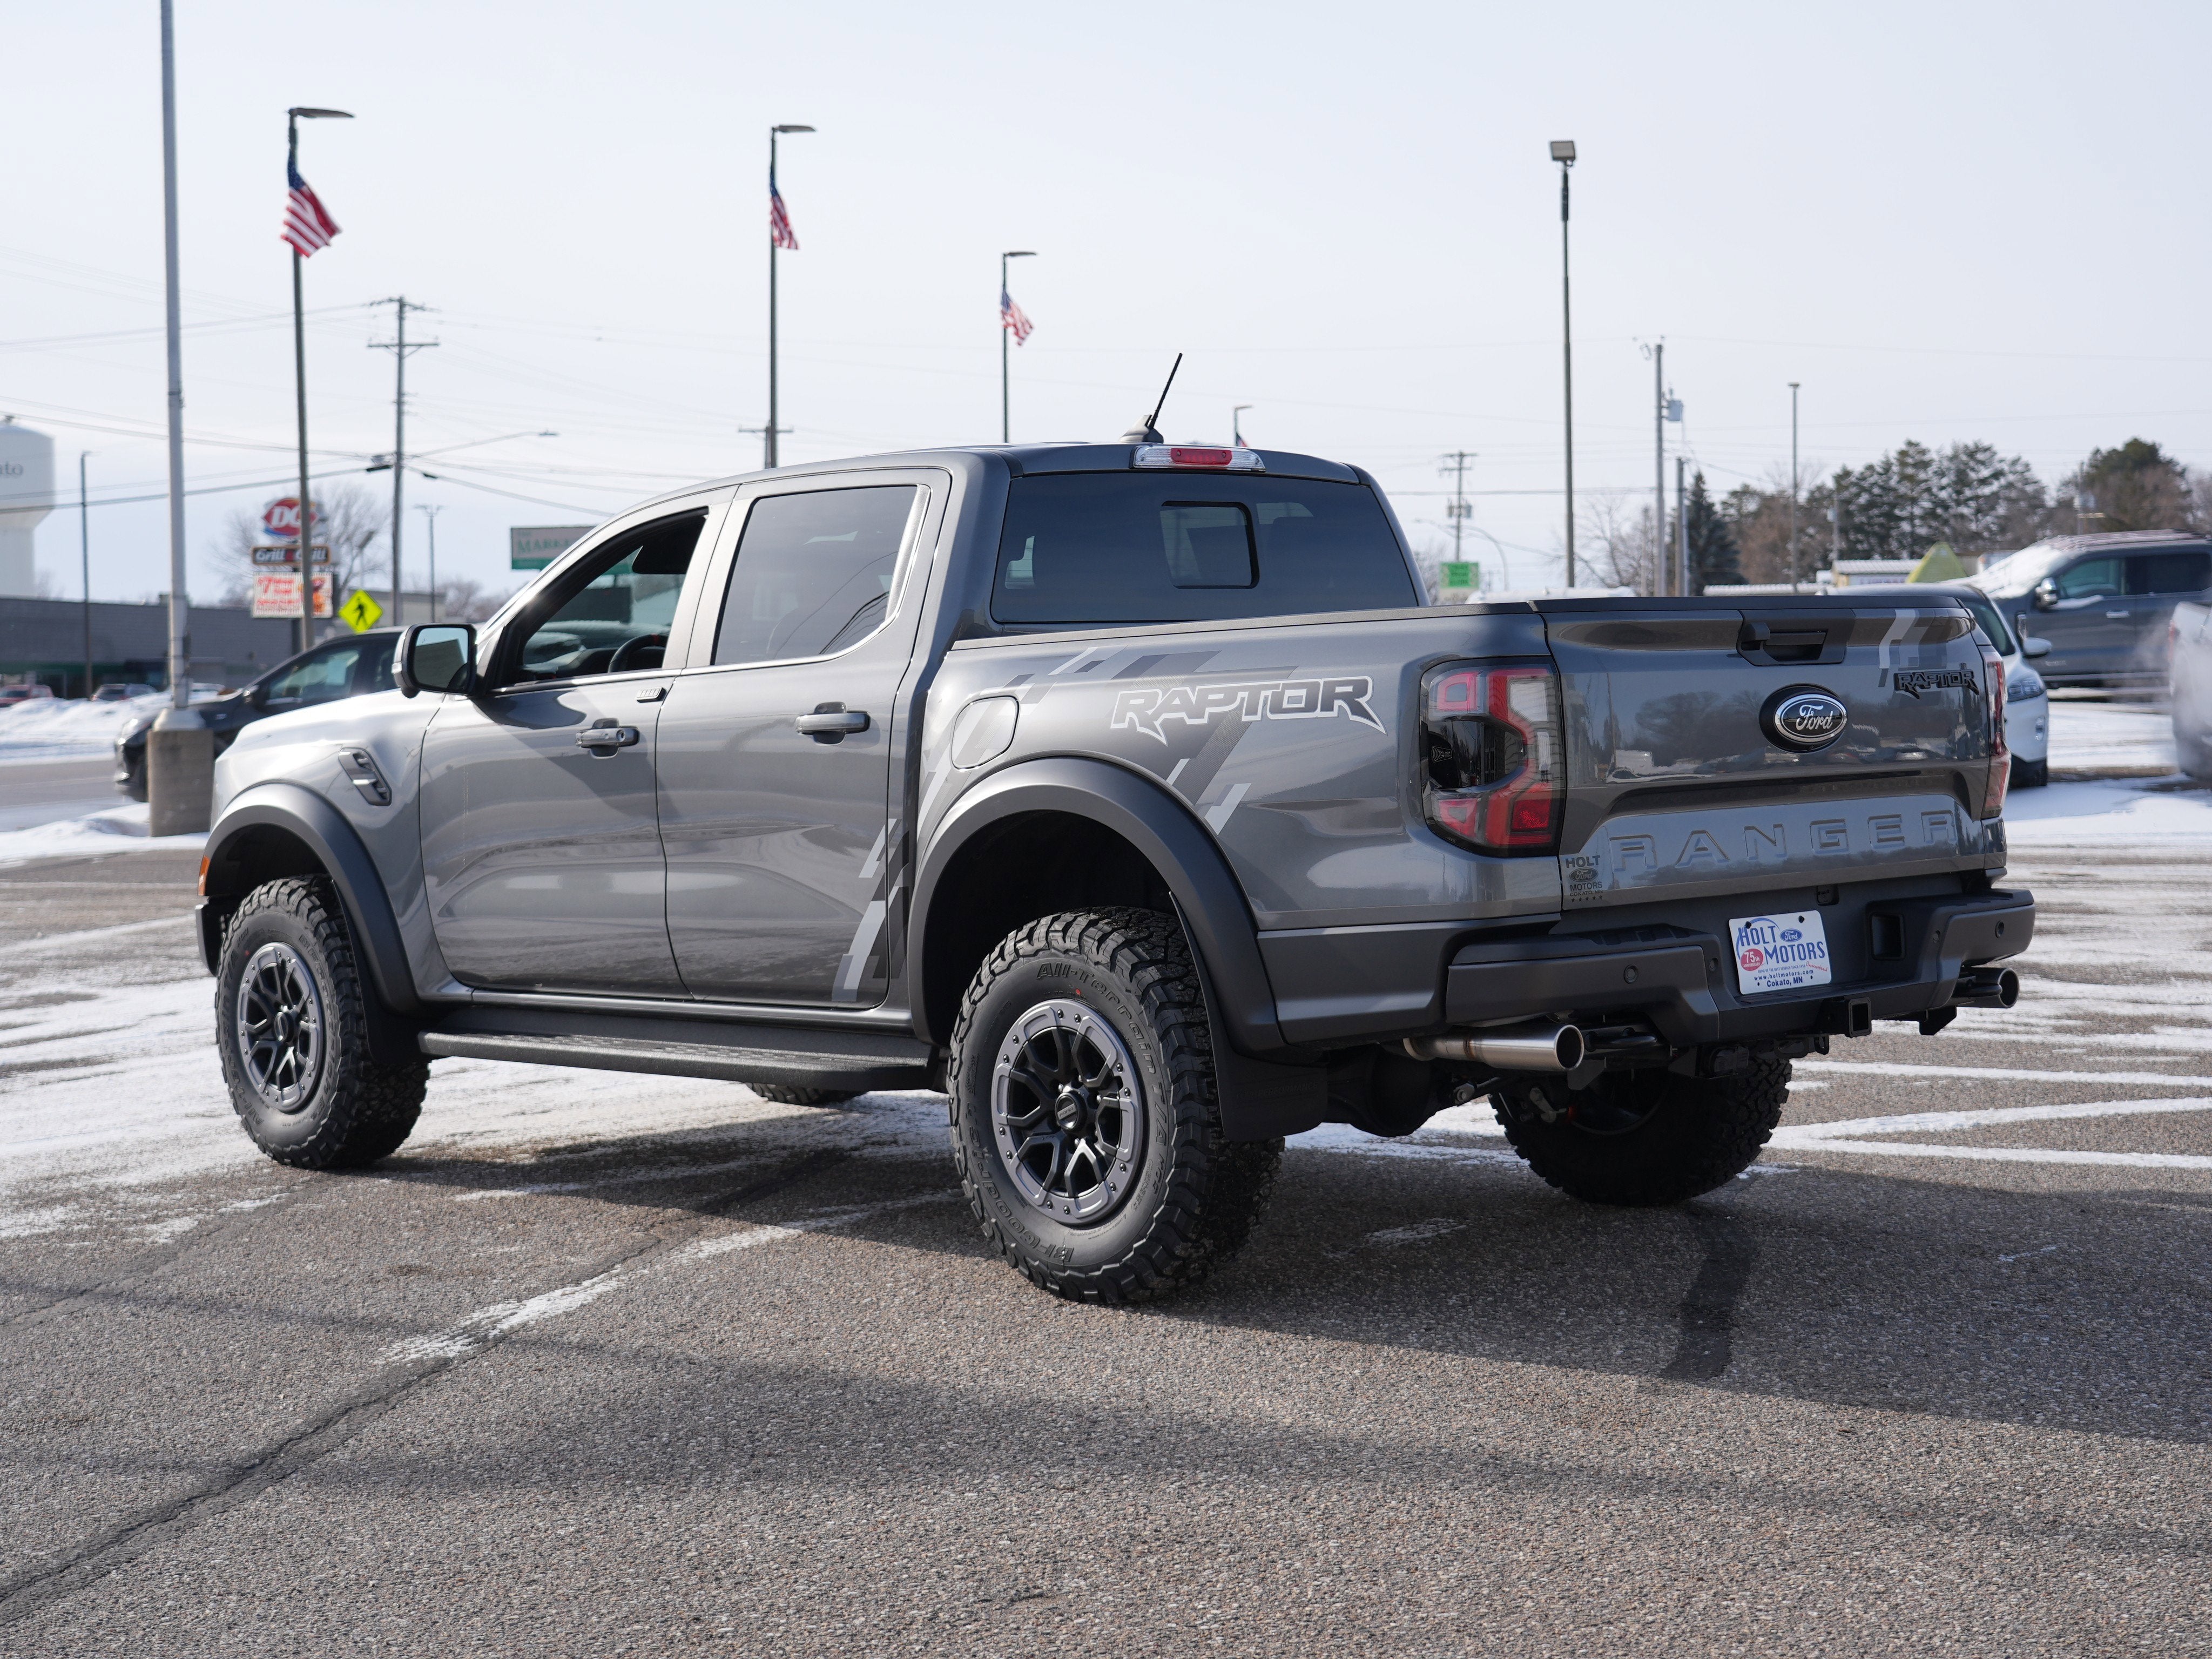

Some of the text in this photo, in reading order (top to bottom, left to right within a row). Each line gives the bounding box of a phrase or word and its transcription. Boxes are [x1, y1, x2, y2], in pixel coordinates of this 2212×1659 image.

[1893, 669, 1980, 699] RAPTOR
[1110, 676, 1387, 746] RAPTOR
[1796, 704, 1833, 731] Ford
[1609, 810, 1957, 873] RANGER
[1566, 855, 1601, 868] HOLT
[1575, 869, 1593, 880] Ford
[1570, 881, 1603, 891] MOTORS
[1738, 925, 1776, 946] HOLT
[1744, 951, 1760, 963] 75th
[1763, 941, 1825, 965] MOTORS
[1754, 969, 1813, 981] www.holtmotors.com
[1766, 979, 1791, 987] Cokato,
